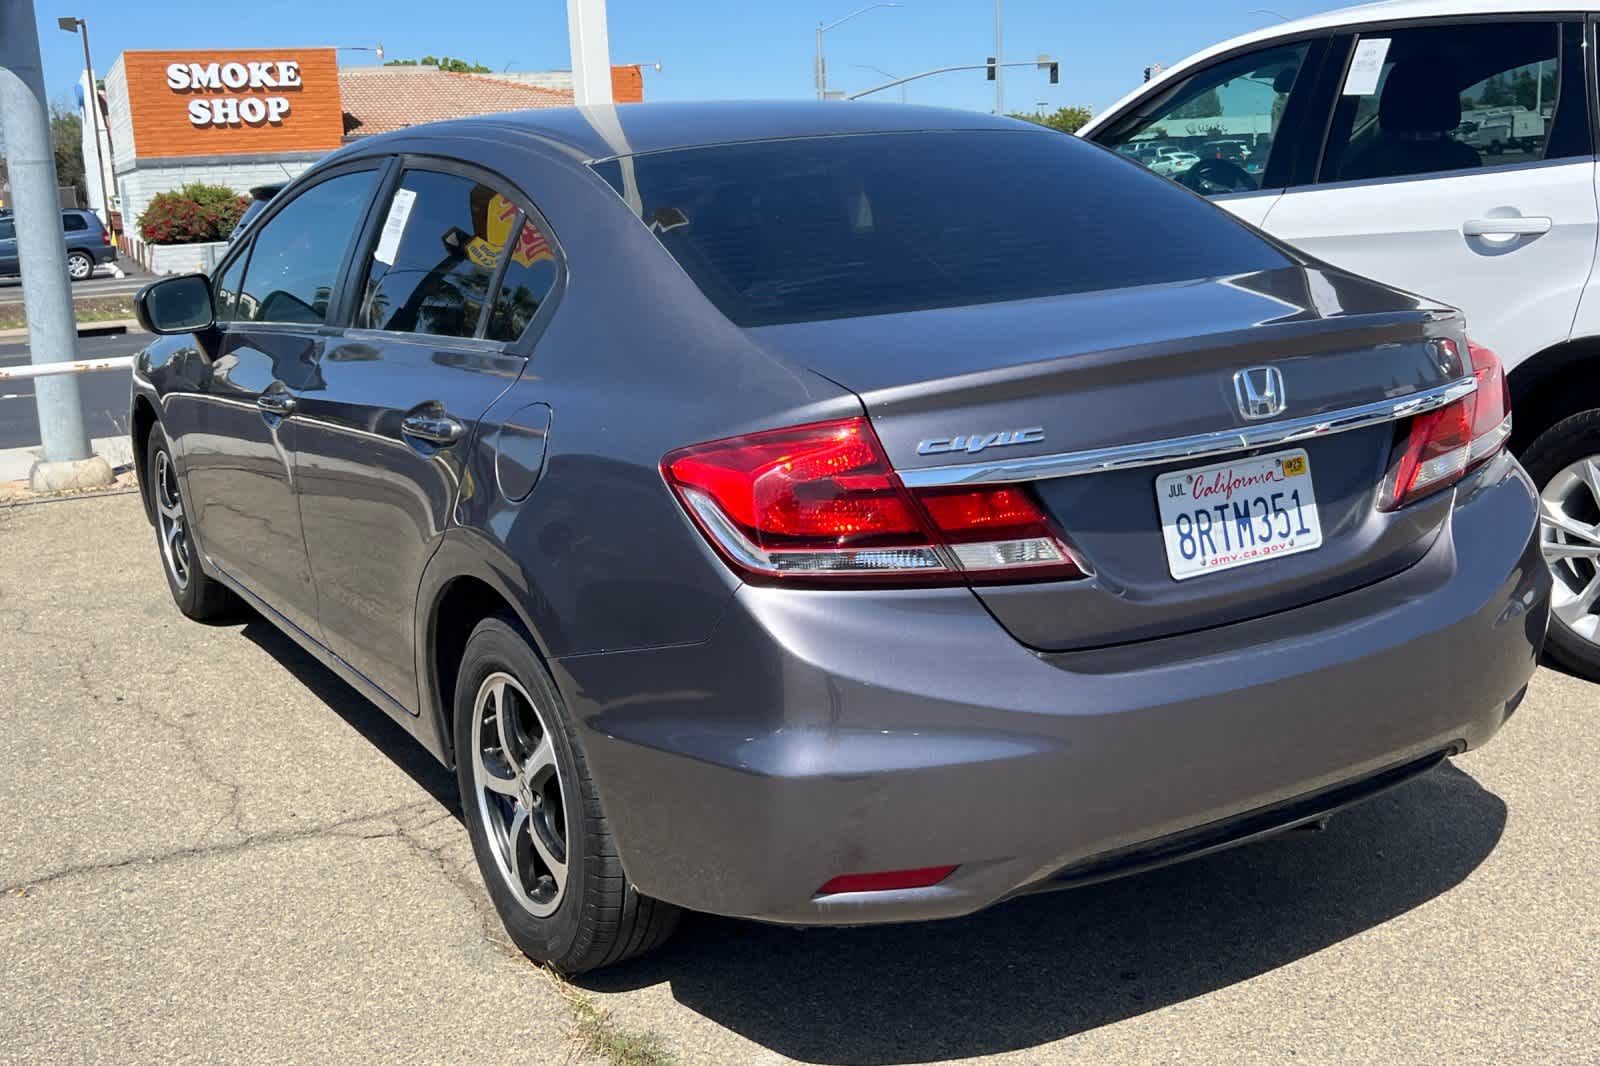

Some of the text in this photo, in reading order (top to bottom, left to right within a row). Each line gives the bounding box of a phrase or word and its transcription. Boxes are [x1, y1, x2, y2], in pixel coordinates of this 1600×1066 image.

[167, 61, 302, 91] SMOKE
[188, 97, 291, 126] SHOP
[917, 427, 1045, 455] CIVIC
[1168, 469, 1285, 500] JUL California
[1175, 489, 1311, 561] 8RTM351
[1210, 543, 1287, 567] dmv.ca.gov
